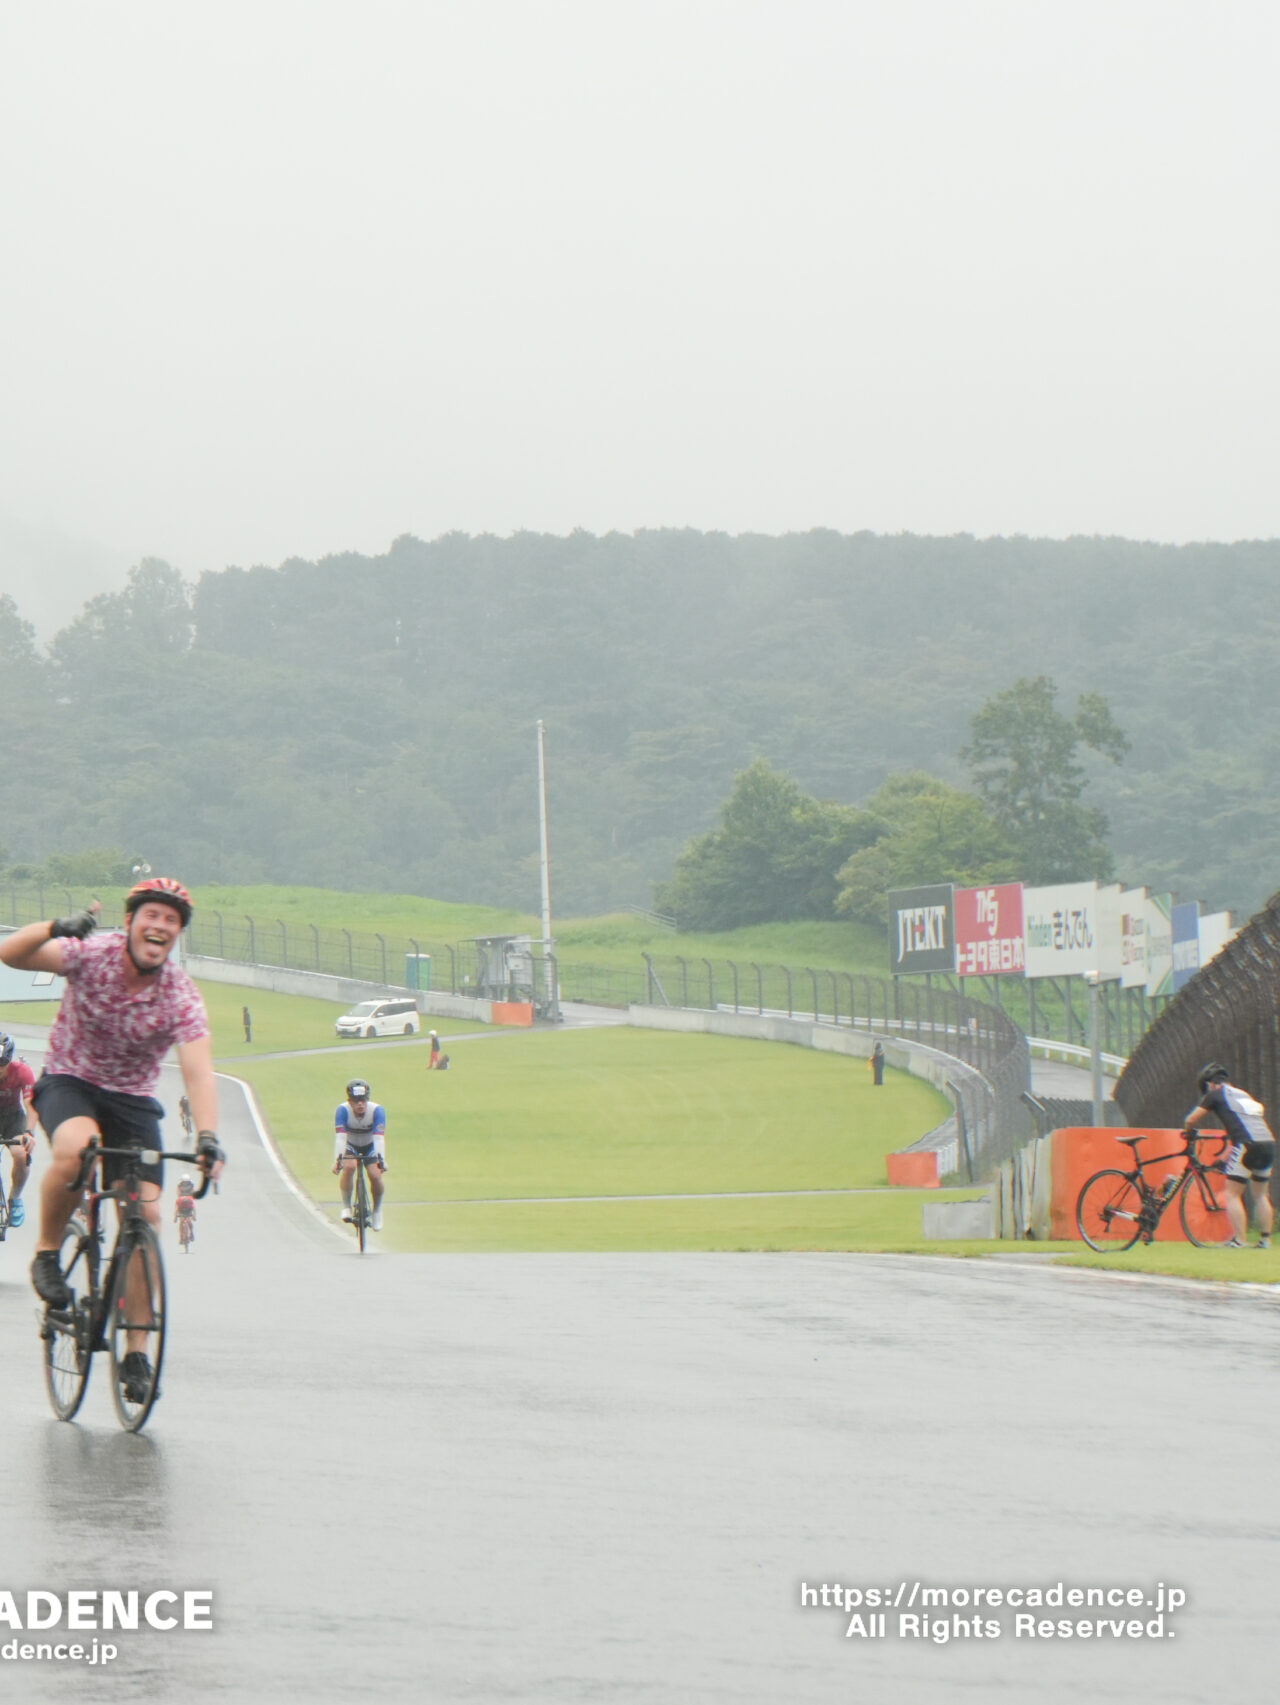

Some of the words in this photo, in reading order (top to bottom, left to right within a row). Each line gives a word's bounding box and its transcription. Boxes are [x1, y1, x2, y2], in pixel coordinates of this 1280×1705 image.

[897, 905, 946, 962] JTEKT
[1052, 907, 1093, 951] きんでん
[956, 936, 1024, 973] トヨタ東日本
